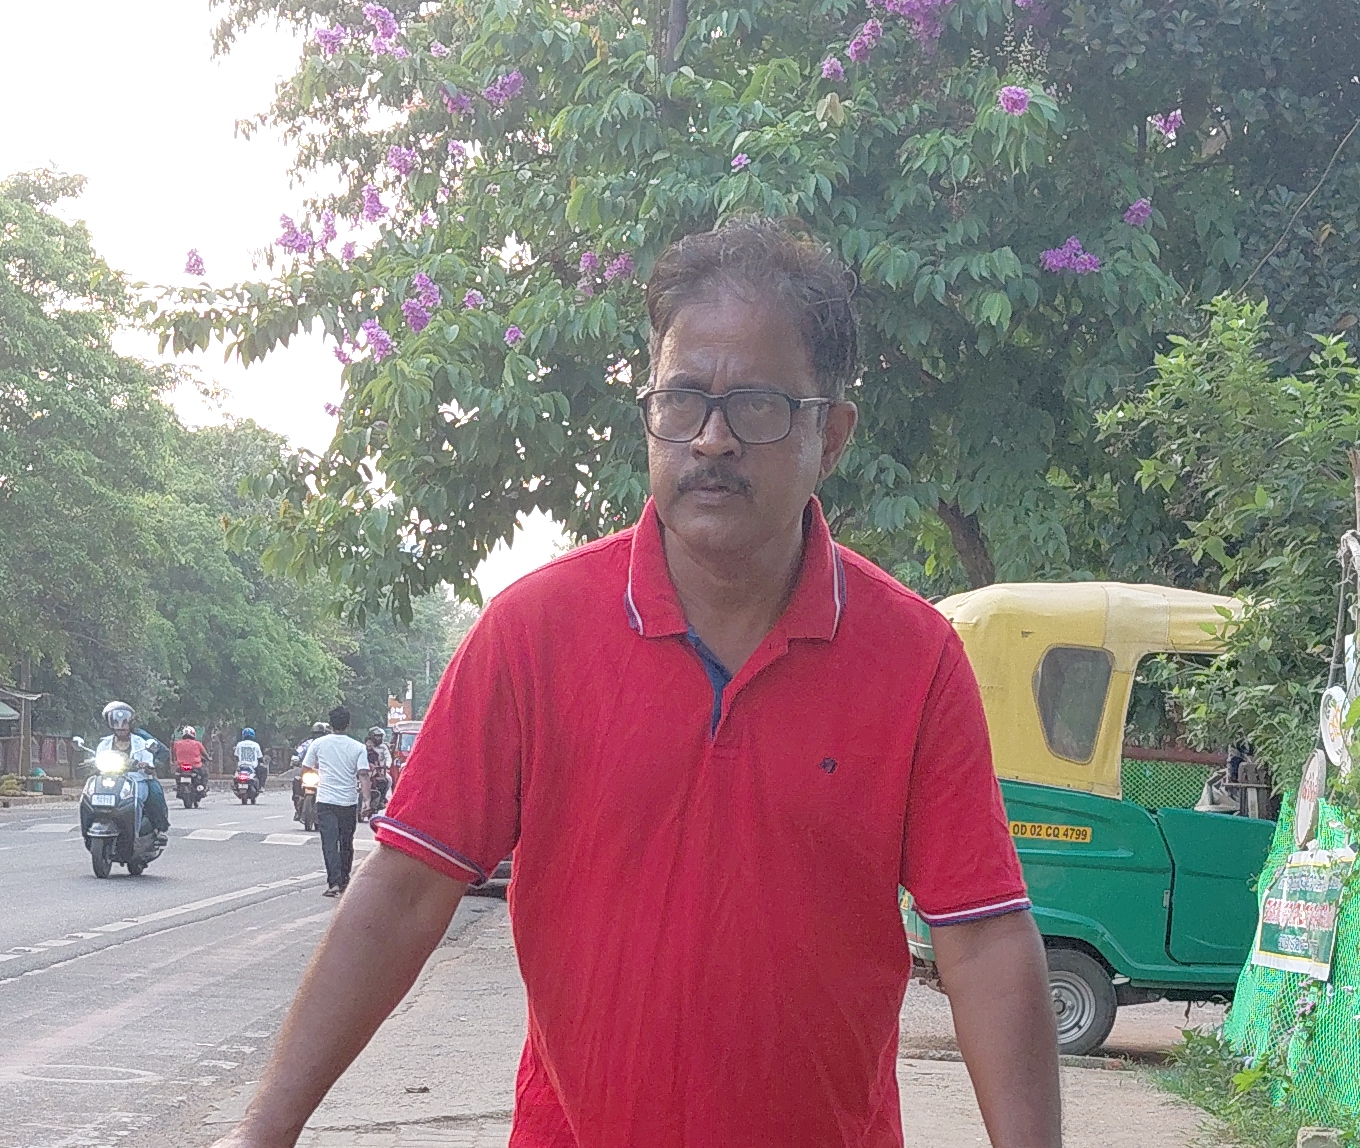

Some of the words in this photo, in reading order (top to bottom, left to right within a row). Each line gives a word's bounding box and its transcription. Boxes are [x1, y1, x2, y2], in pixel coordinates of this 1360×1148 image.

[1013, 824, 1027, 836] OD
[1030, 825, 1042, 837] 02
[1045, 826, 1060, 838] CQ
[1063, 828, 1088, 841] 4799
